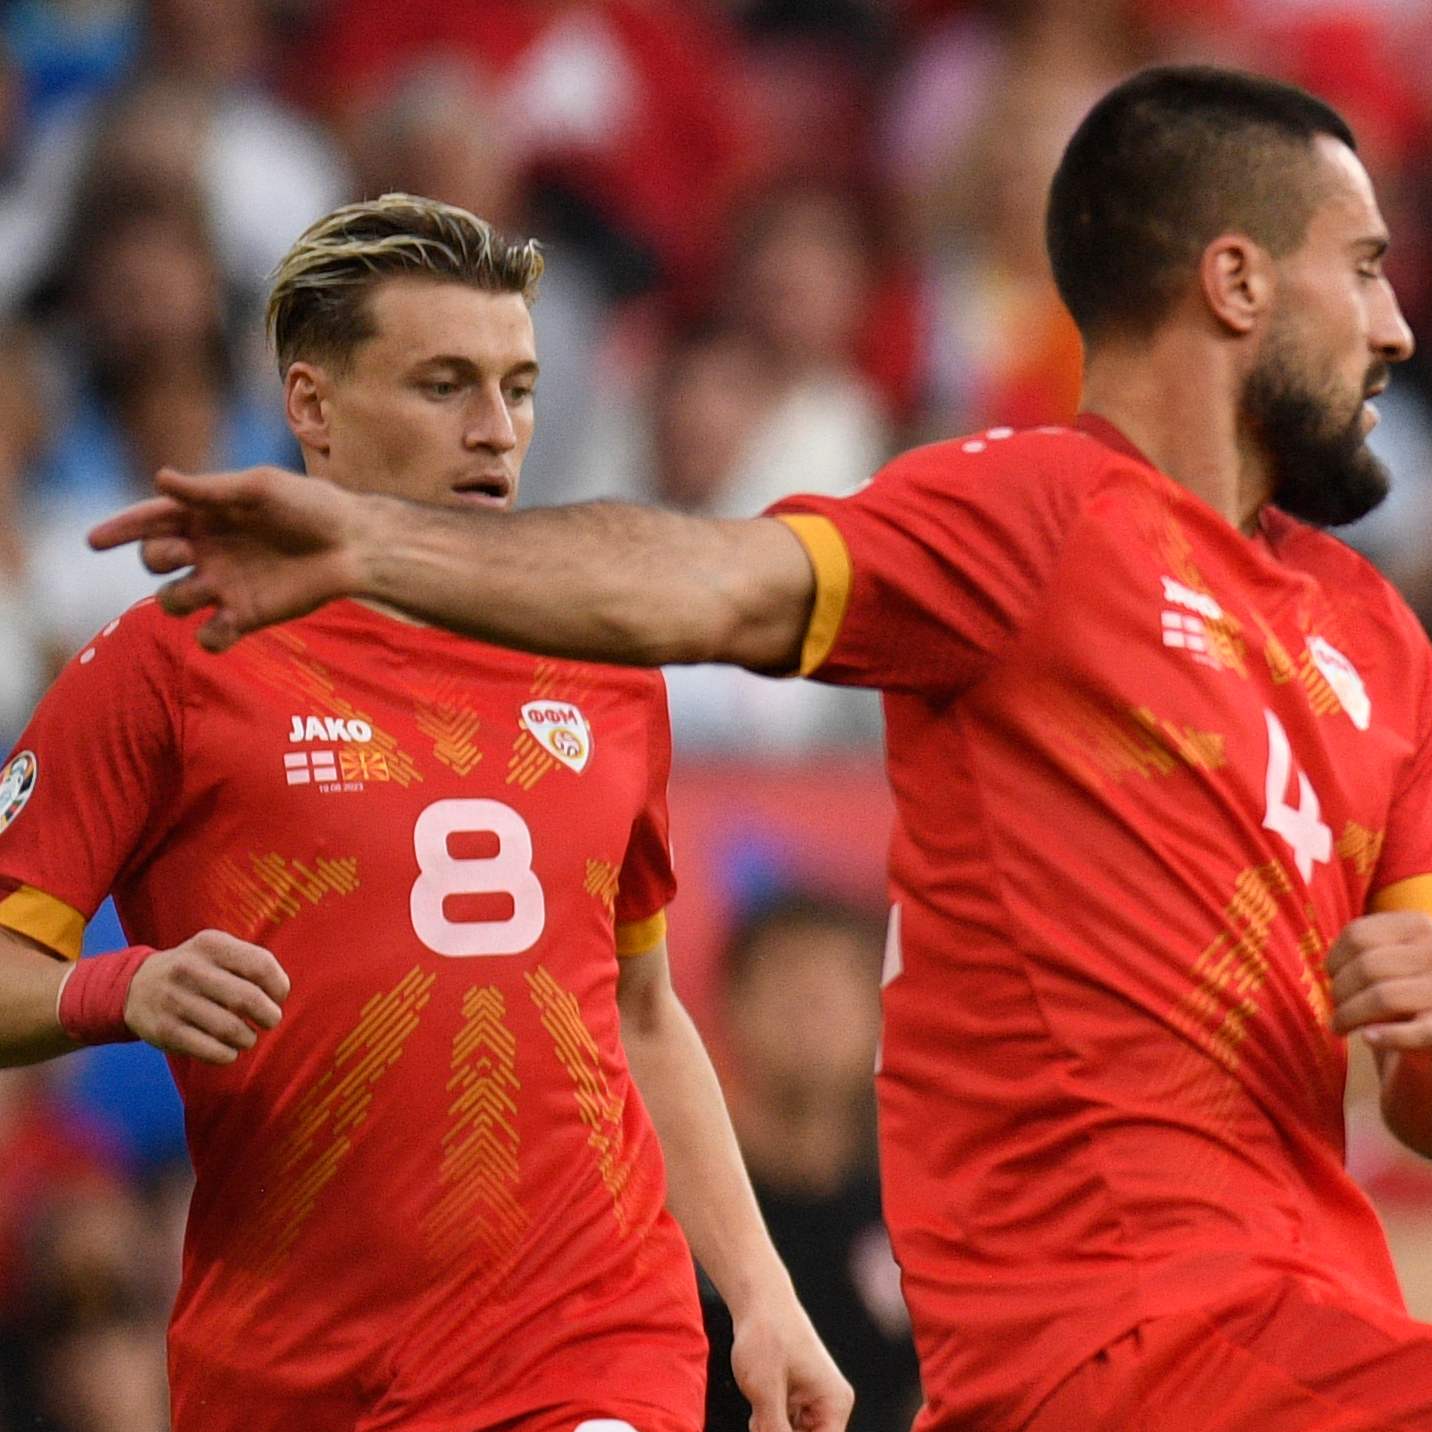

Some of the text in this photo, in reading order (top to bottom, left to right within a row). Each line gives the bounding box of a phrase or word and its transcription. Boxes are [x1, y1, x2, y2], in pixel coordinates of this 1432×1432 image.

[289, 715, 372, 742] JAKO
[1262, 708, 1333, 886] 4
[410, 798, 545, 958] 8
